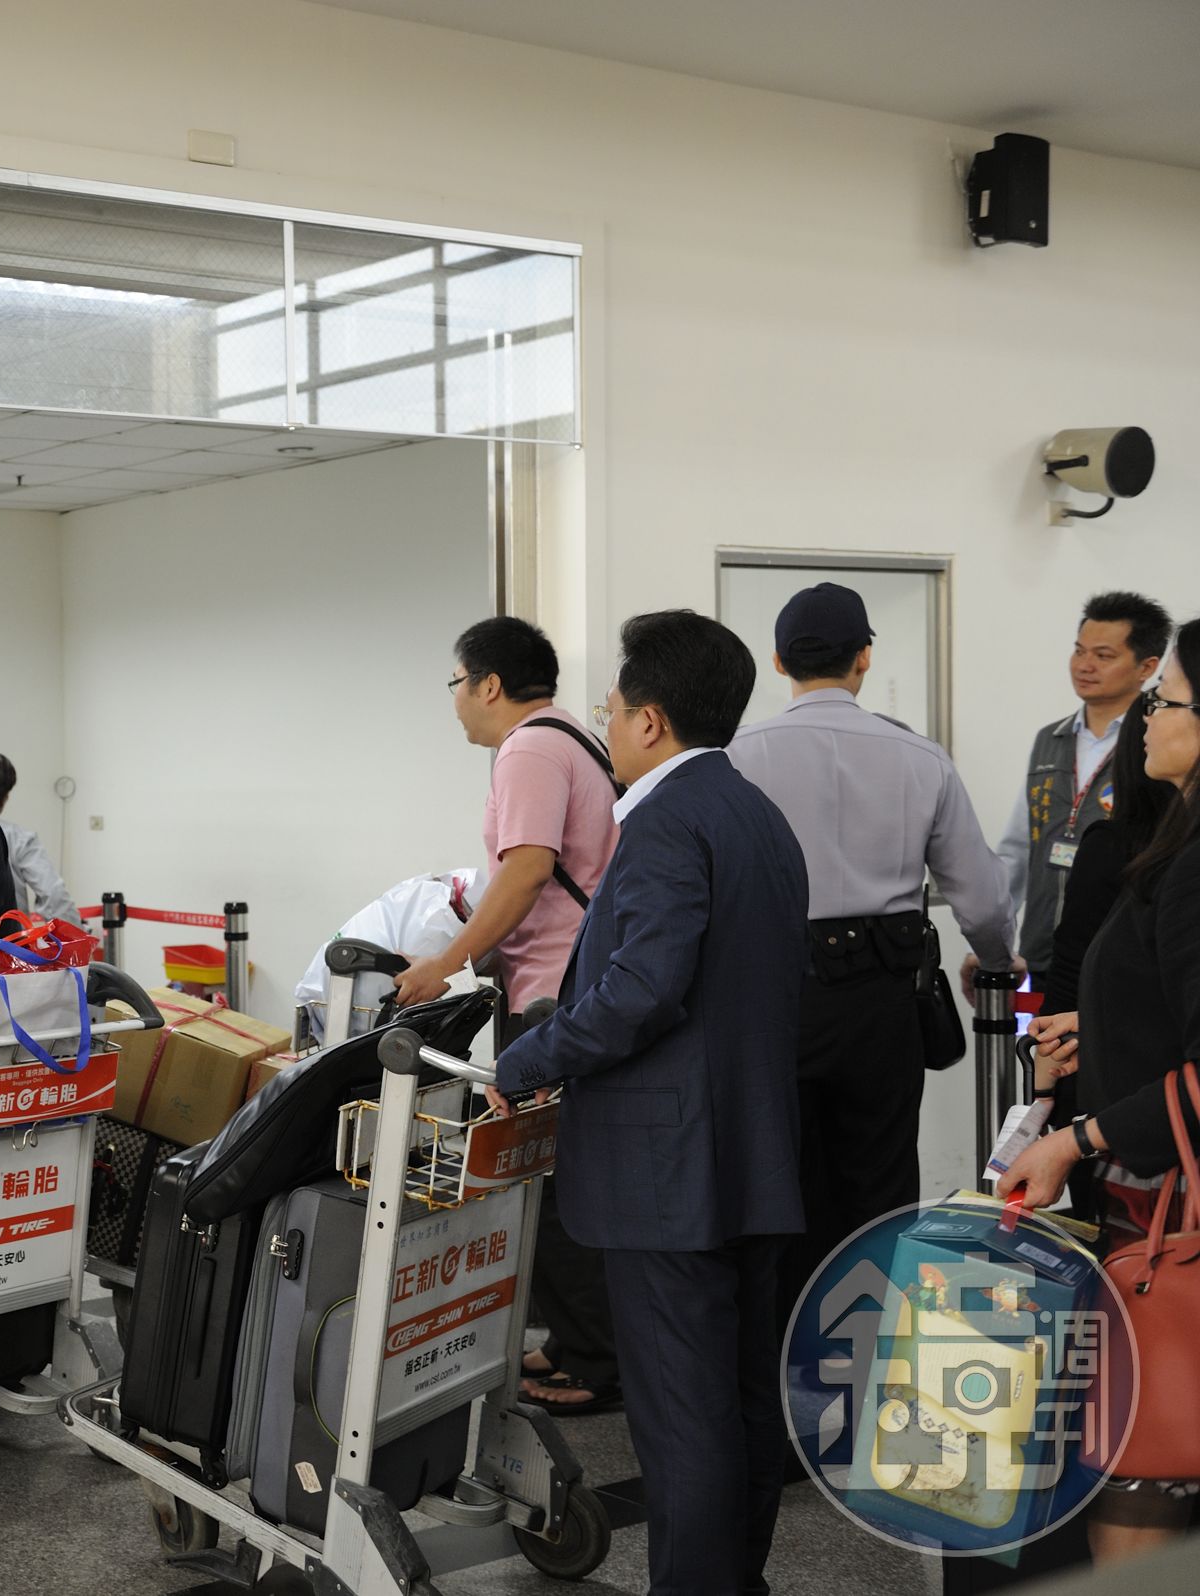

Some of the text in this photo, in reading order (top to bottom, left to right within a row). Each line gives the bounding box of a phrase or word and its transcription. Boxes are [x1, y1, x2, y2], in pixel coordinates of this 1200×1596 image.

[39, 1083, 78, 1105] 輪胎
[494, 1145, 524, 1175] 正新
[2, 1165, 59, 1200] 輪胎
[9, 1217, 55, 1236] TIRE
[393, 1230, 507, 1304] 正新 輪胎
[387, 1292, 500, 1352] CHENG SHIN TIRE
[414, 1362, 462, 1392] www.cst.com.tw
